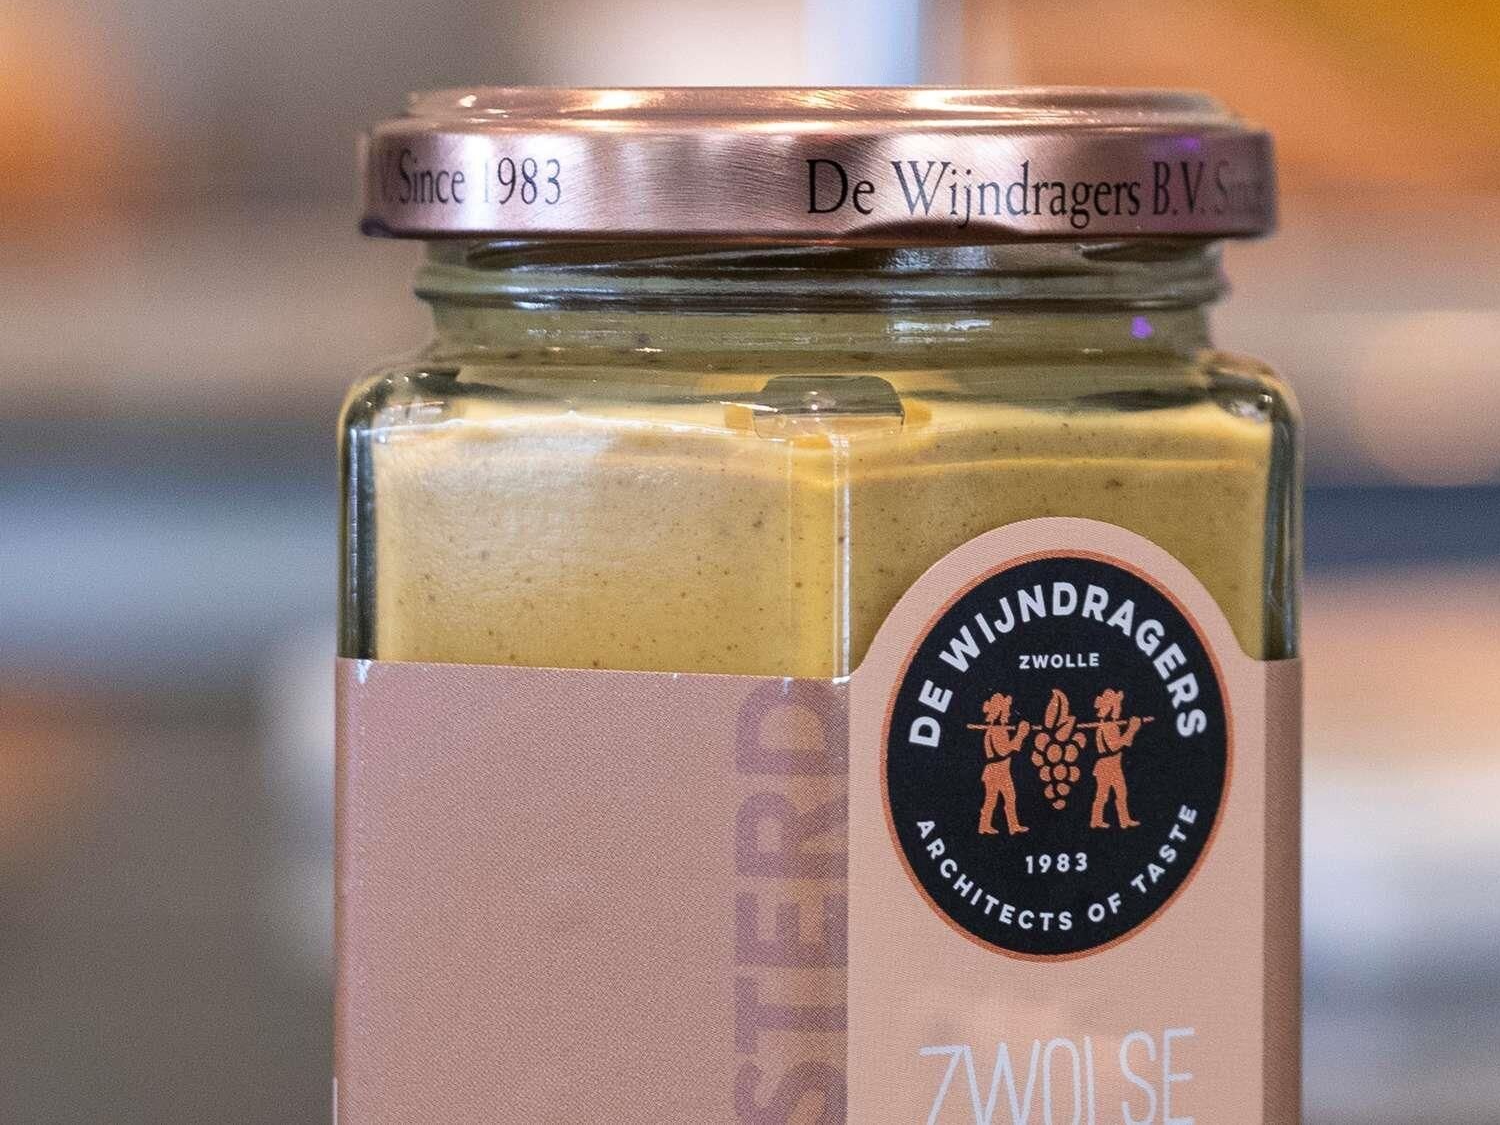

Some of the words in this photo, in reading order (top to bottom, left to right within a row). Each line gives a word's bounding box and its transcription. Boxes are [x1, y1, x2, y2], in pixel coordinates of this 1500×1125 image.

[399, 148, 466, 205] Since
[483, 157, 562, 205] 1983
[806, 158, 876, 215] De
[890, 158, 1142, 229] Wijndragers
[908, 679, 954, 748] DE
[938, 581, 1208, 738] WIJNDRAGERS
[1018, 652, 1100, 670] ZWOLLE
[916, 819, 1073, 932] ARCHITECTS
[1087, 892, 1123, 923] OF
[1130, 803, 1198, 895] TASTE
[1025, 851, 1089, 874] 1983
